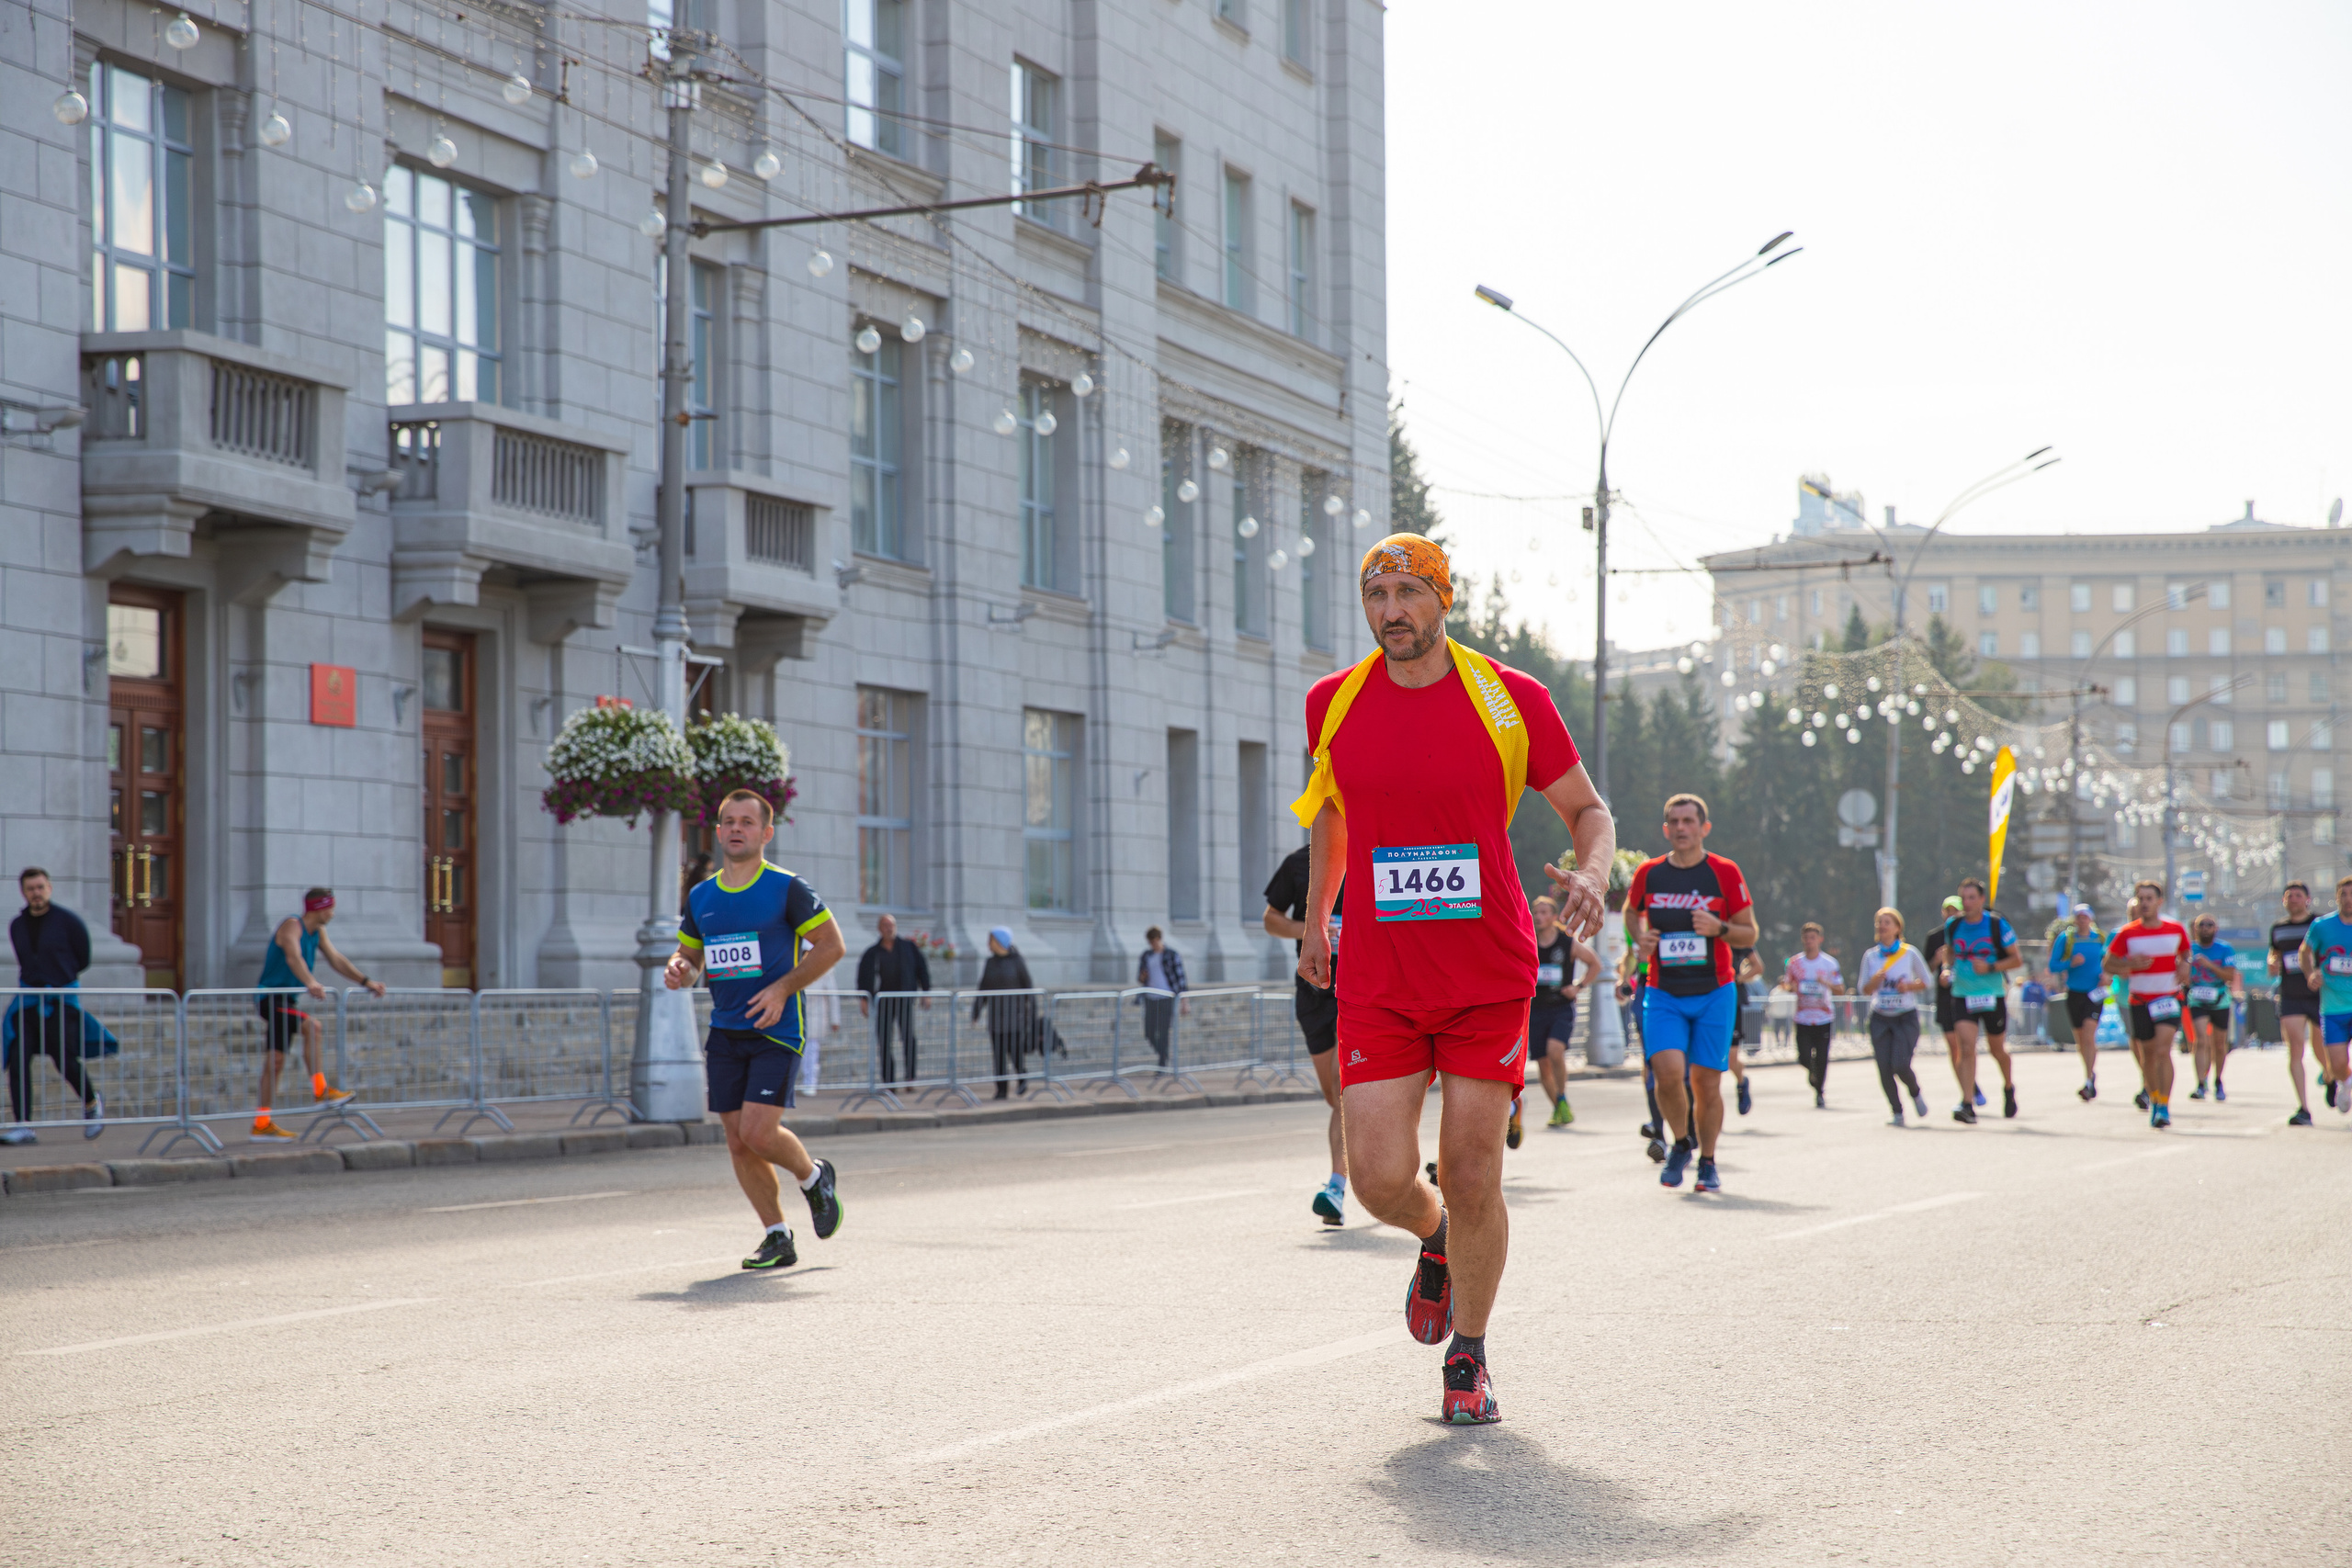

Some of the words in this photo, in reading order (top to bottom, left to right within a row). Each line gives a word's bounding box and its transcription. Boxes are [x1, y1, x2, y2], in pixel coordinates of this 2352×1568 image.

[1387, 850, 1457, 858] ПОЛУМАРАФОН
[1389, 866, 1465, 894] 1466
[1410, 897, 1442, 917] 26
[711, 946, 752, 964] 1008
[1669, 941, 1695, 953] 696
